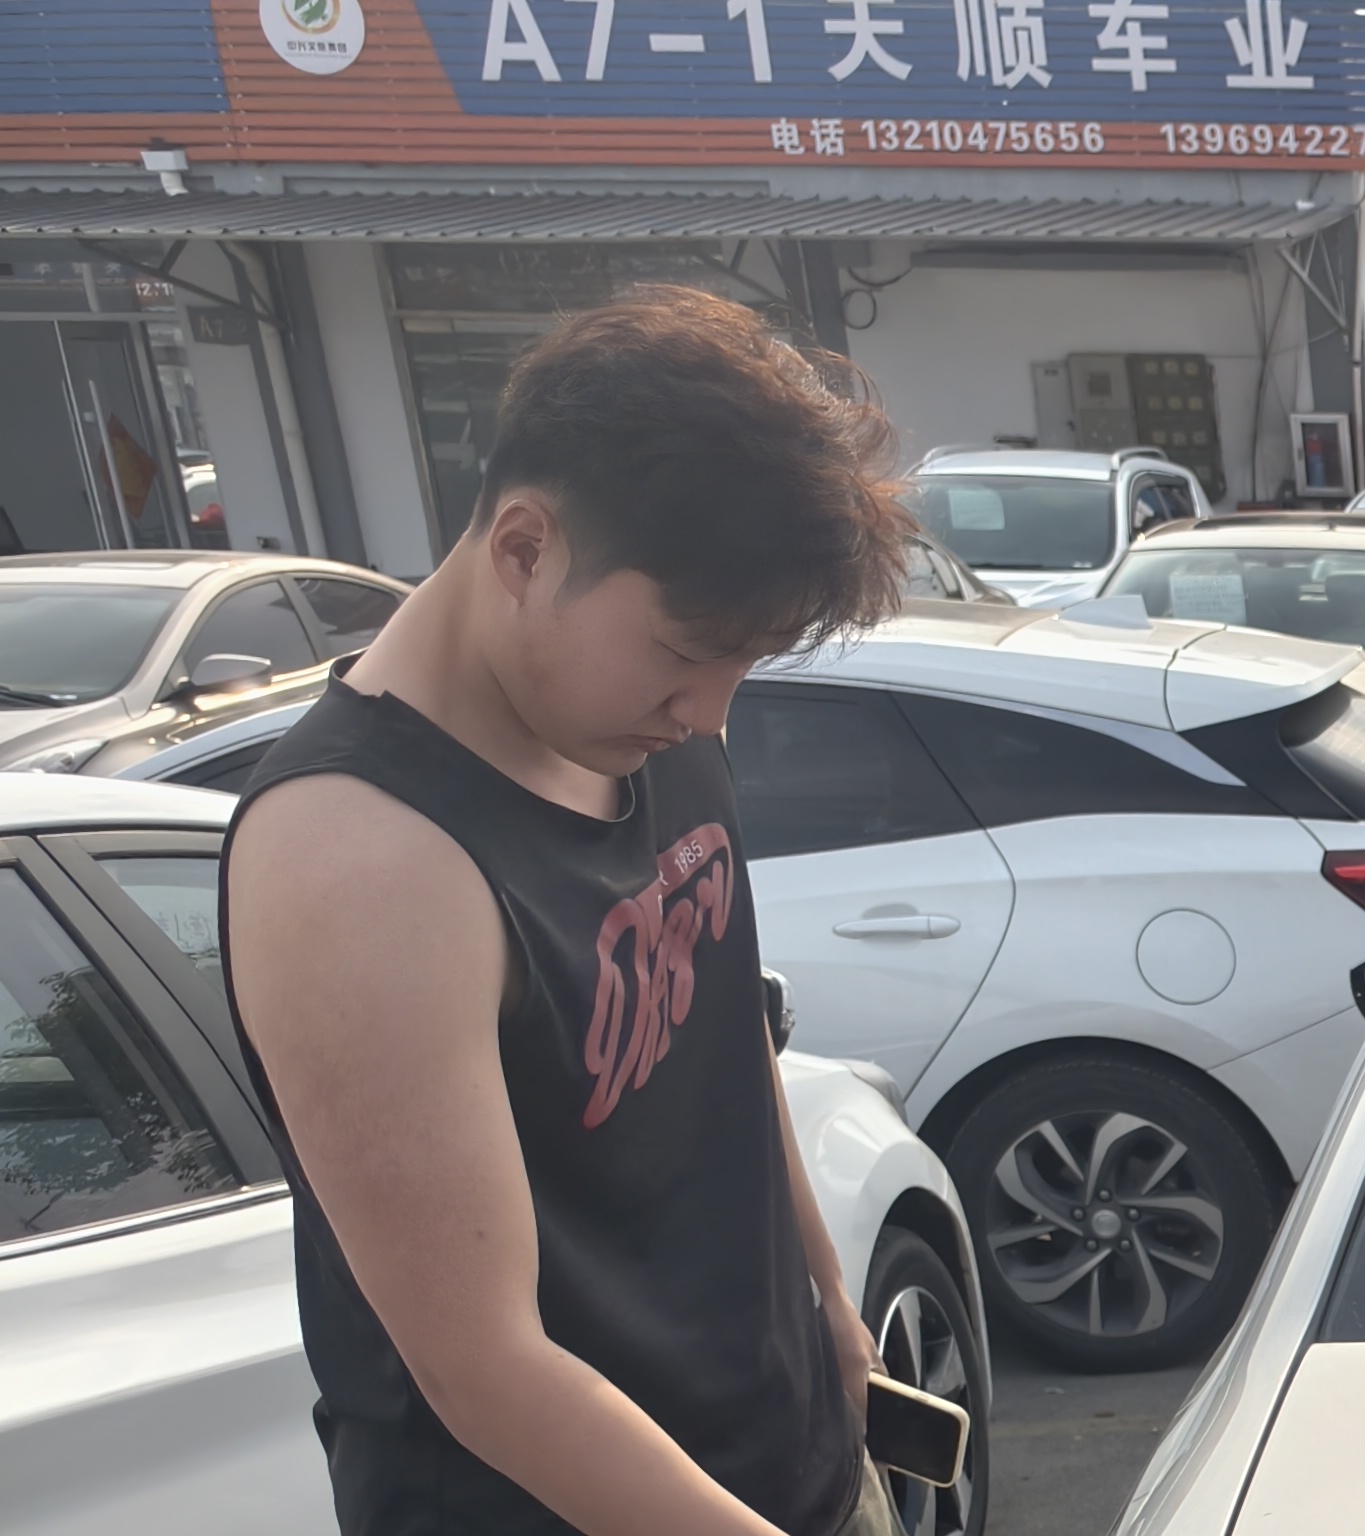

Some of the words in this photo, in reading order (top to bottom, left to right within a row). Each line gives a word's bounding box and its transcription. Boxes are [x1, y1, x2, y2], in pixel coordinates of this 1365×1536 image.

[771, 118, 845, 156] 电话
[861, 119, 1104, 153] 13210475656
[674, 839, 703, 874] 1985
